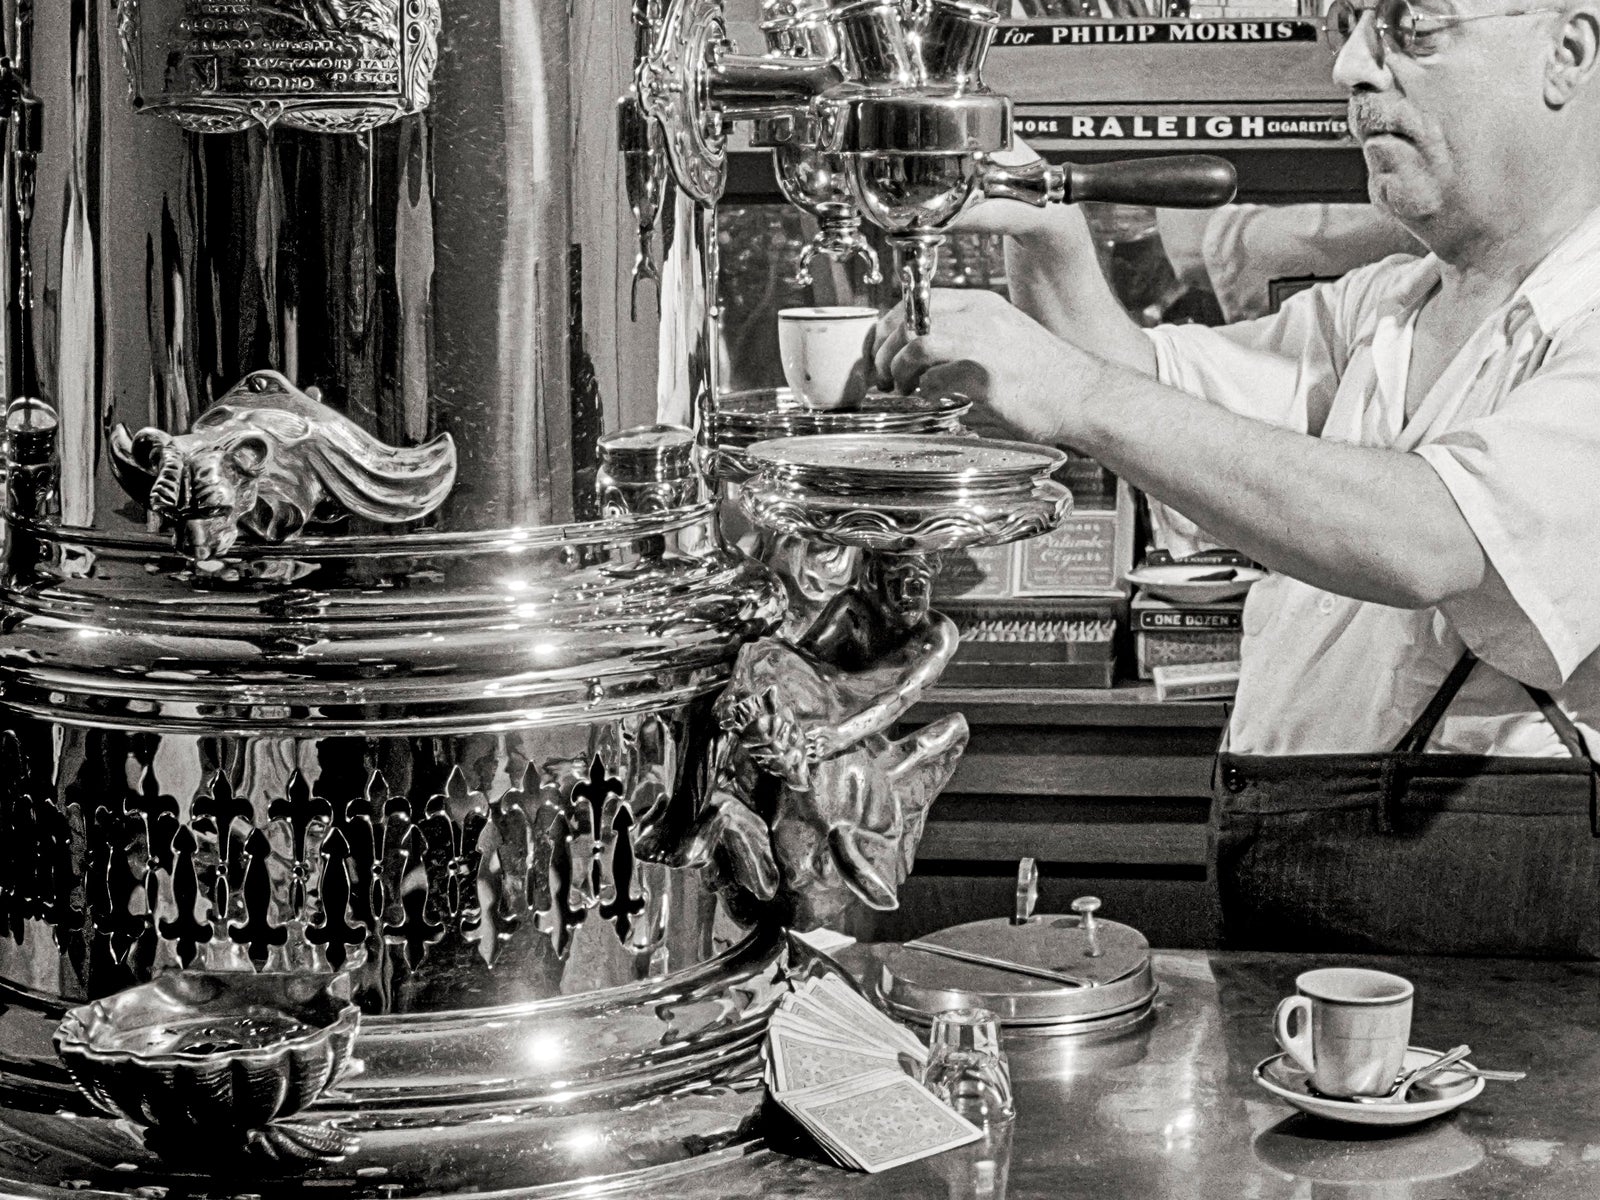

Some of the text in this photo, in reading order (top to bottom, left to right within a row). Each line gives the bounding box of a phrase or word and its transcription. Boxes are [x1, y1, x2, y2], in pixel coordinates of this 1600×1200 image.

[1002, 27, 1035, 45] for
[1052, 24, 1156, 44] PHILIP
[1169, 21, 1294, 42] MORRIS
[356, 58, 399, 71] ITALIA
[243, 75, 315, 90] TORINO
[1013, 115, 1348, 138] MOKE RALEIGH CIGARETTES
[1154, 614, 1229, 626] ONE DOZEN
